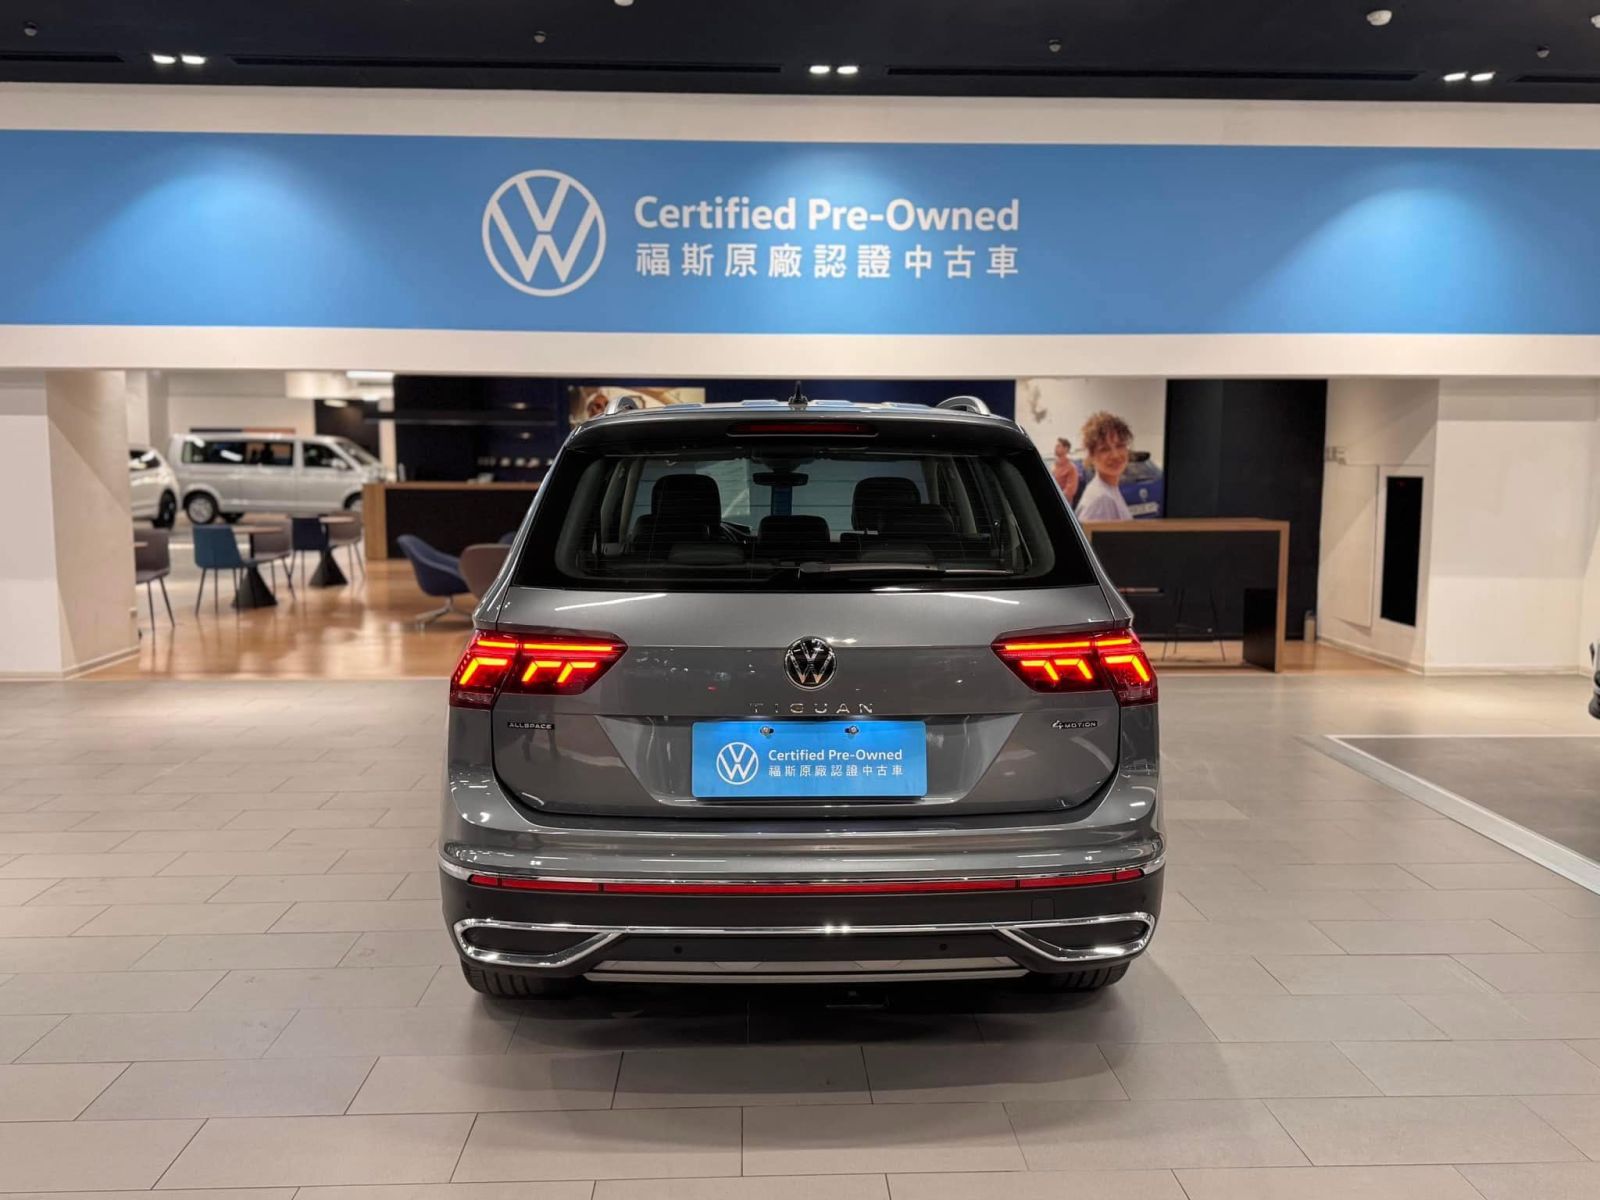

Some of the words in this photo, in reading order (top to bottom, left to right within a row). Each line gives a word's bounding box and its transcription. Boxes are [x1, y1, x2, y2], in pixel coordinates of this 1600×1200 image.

[634, 196, 797, 230] Certified
[807, 198, 1020, 232] Pre-Owned
[635, 242, 1019, 279] 福斯原廠認證中古車
[749, 703, 873, 714] TIGUAN
[768, 749, 825, 761] Certified
[828, 749, 903, 761] Pre-Owned
[768, 764, 904, 777] 福斯原廠認證中古車
